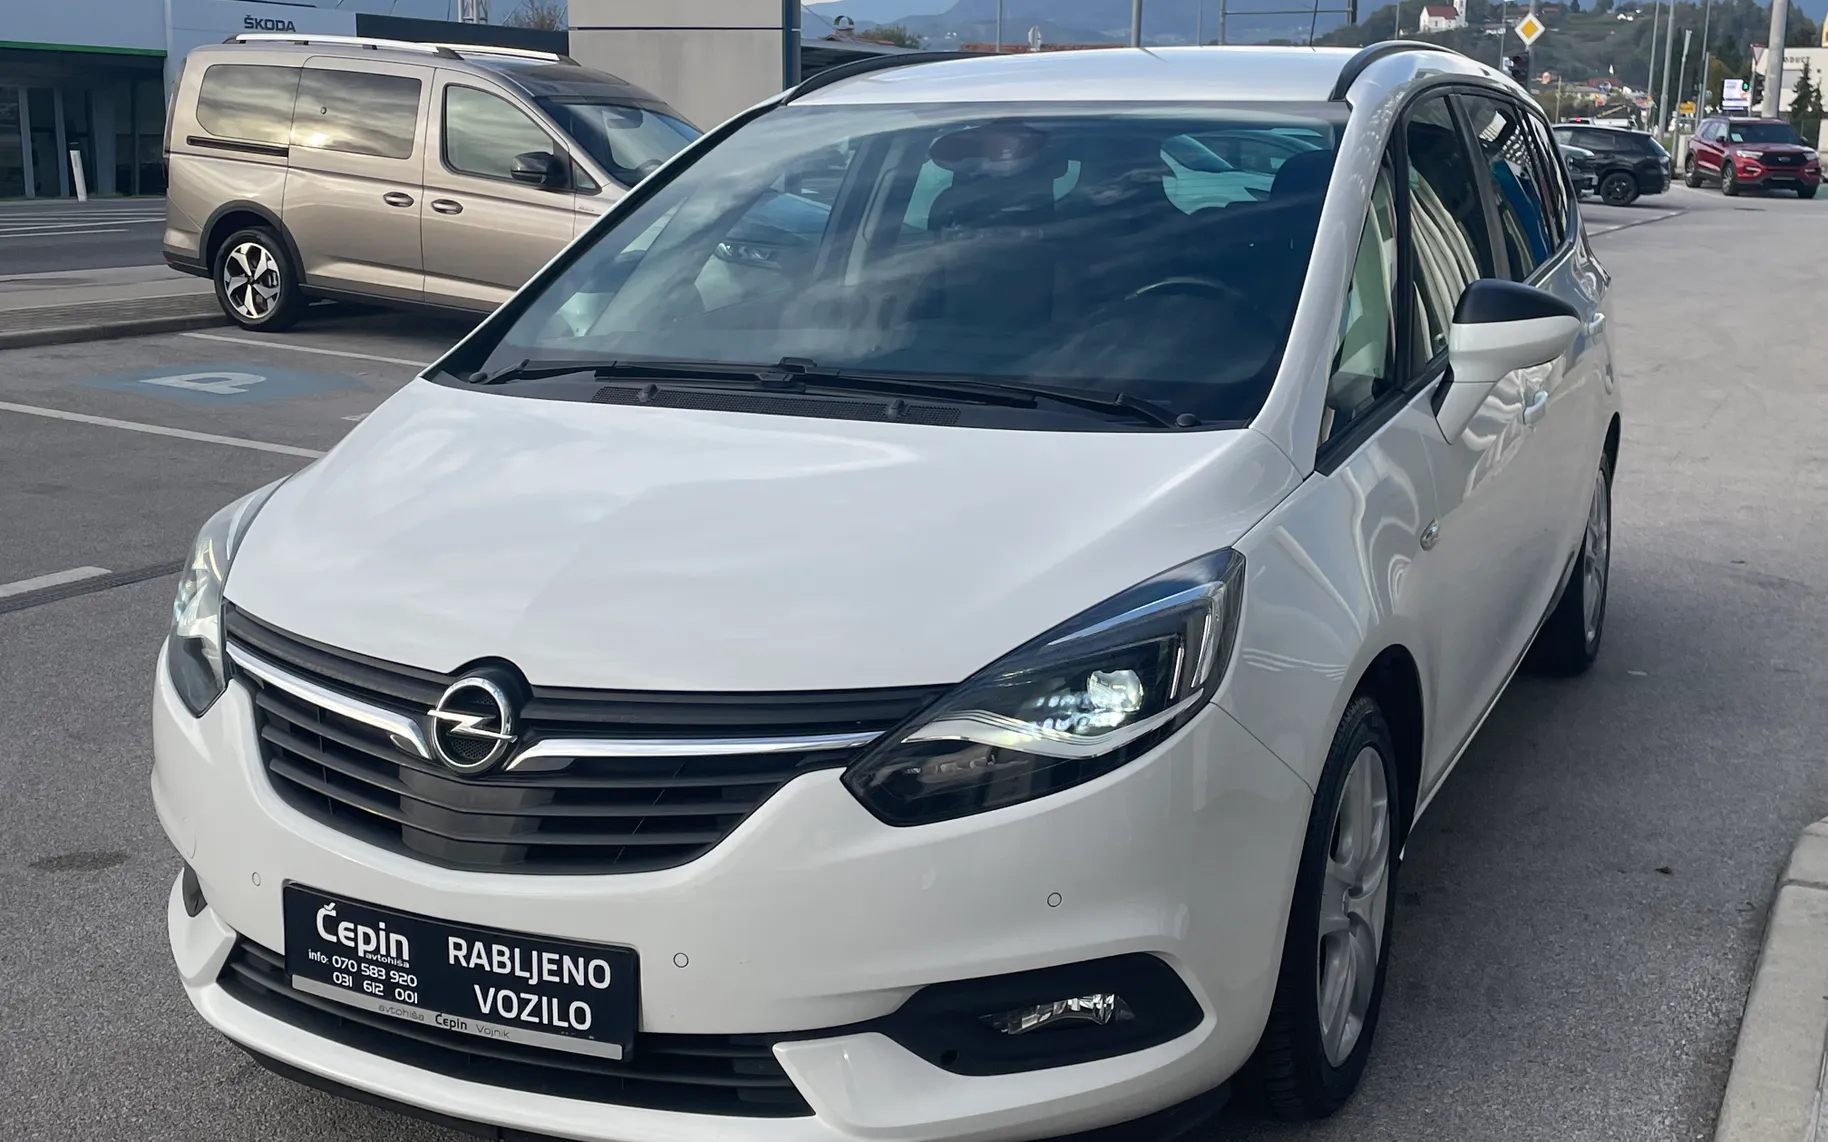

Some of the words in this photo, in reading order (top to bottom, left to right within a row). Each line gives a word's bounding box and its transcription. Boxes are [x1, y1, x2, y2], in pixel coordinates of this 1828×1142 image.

[243, 14, 296, 32] ŠKODA
[316, 902, 410, 961] Čepin
[308, 949, 330, 965] info:
[332, 955, 357, 972] 070
[361, 963, 386, 980] 583
[389, 970, 417, 987] 920
[448, 936, 611, 989] RABLJENO
[333, 971, 353, 988] 031
[363, 980, 384, 996] 612
[395, 988, 418, 1004] 001
[378, 1004, 425, 1022] avtohiša
[435, 1012, 468, 1031] Čepin
[475, 1024, 510, 1039] Vojnik
[473, 984, 592, 1031] VOZILO
